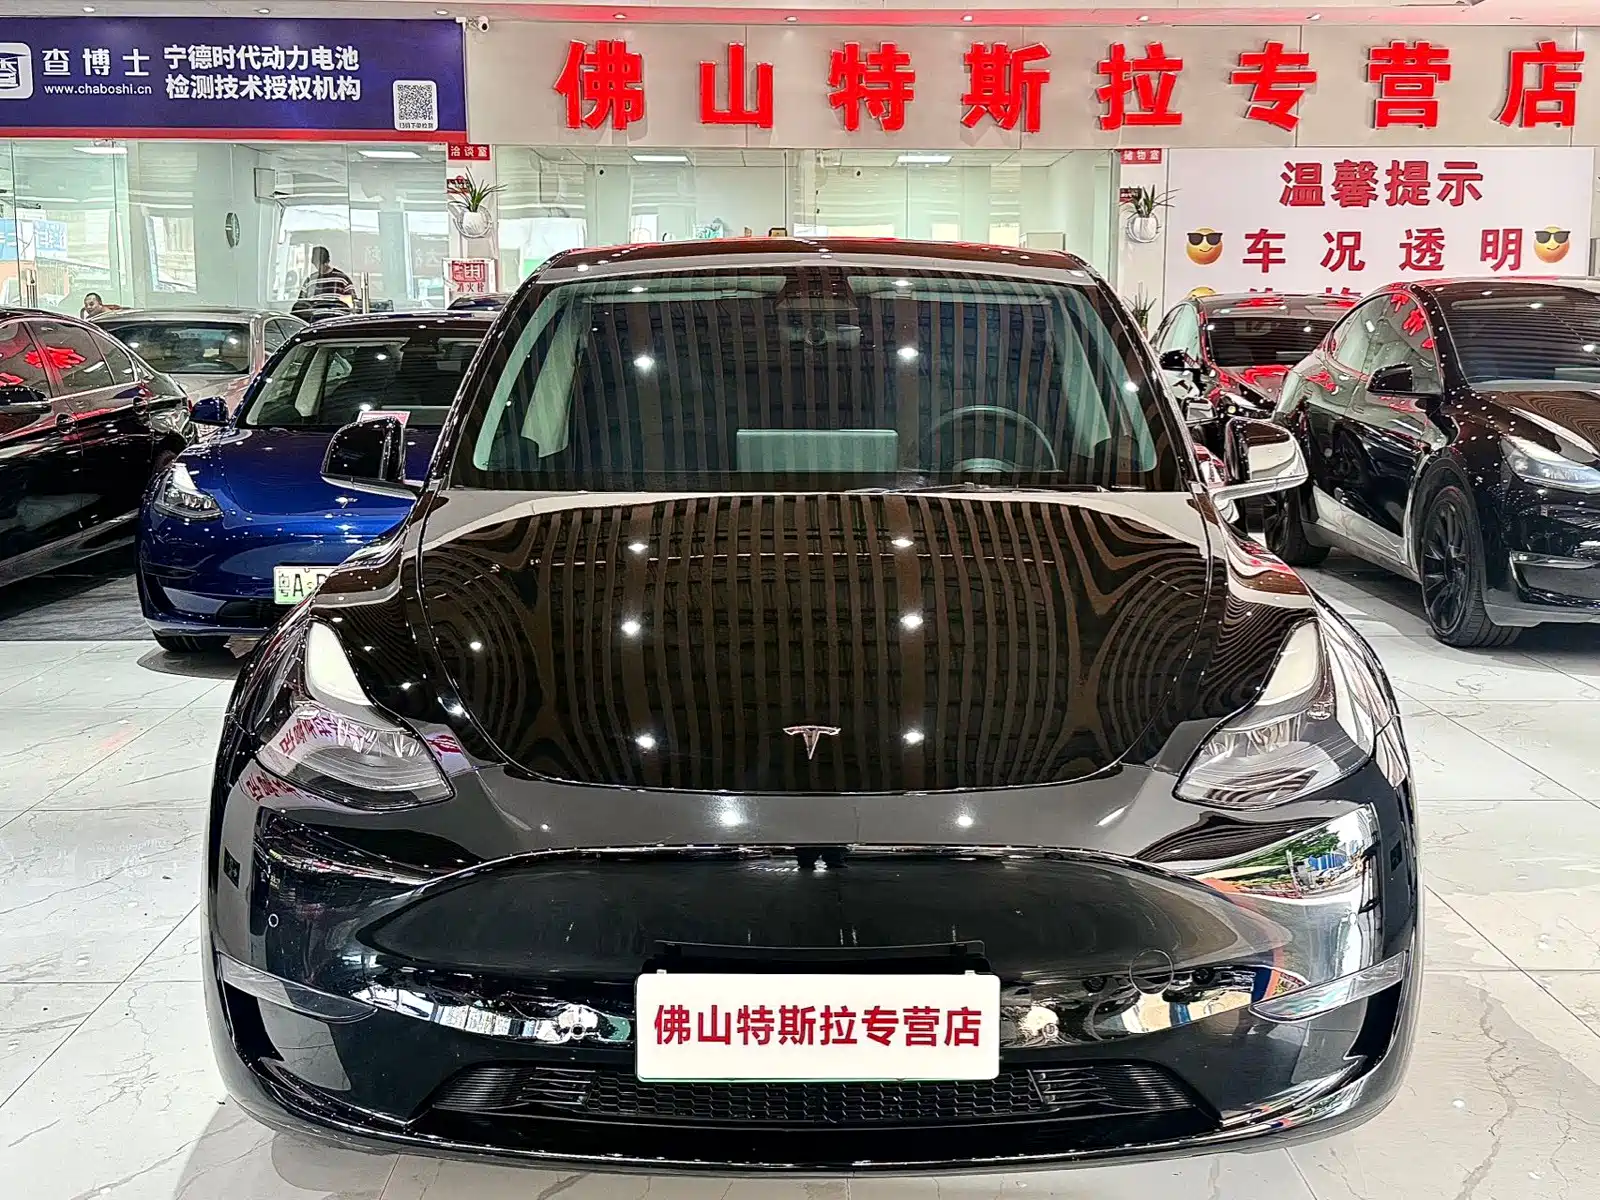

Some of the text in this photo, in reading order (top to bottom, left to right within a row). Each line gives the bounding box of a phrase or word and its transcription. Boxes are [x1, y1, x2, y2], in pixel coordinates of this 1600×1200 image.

[41, 48, 150, 76] 查博士
[163, 44, 360, 71] 宁德时代动力电池
[44, 82, 152, 96] www.chaboshi.cn
[165, 73, 362, 101] 检测技术授权机构
[552, 39, 1584, 133] 佛山特斯拉专营店
[450, 145, 488, 157] 洽谈室
[1279, 159, 1484, 208] 温馨提示
[1242, 228, 1523, 273] 车况透明
[654, 1004, 982, 1047] 佛山特斯拉专营店
